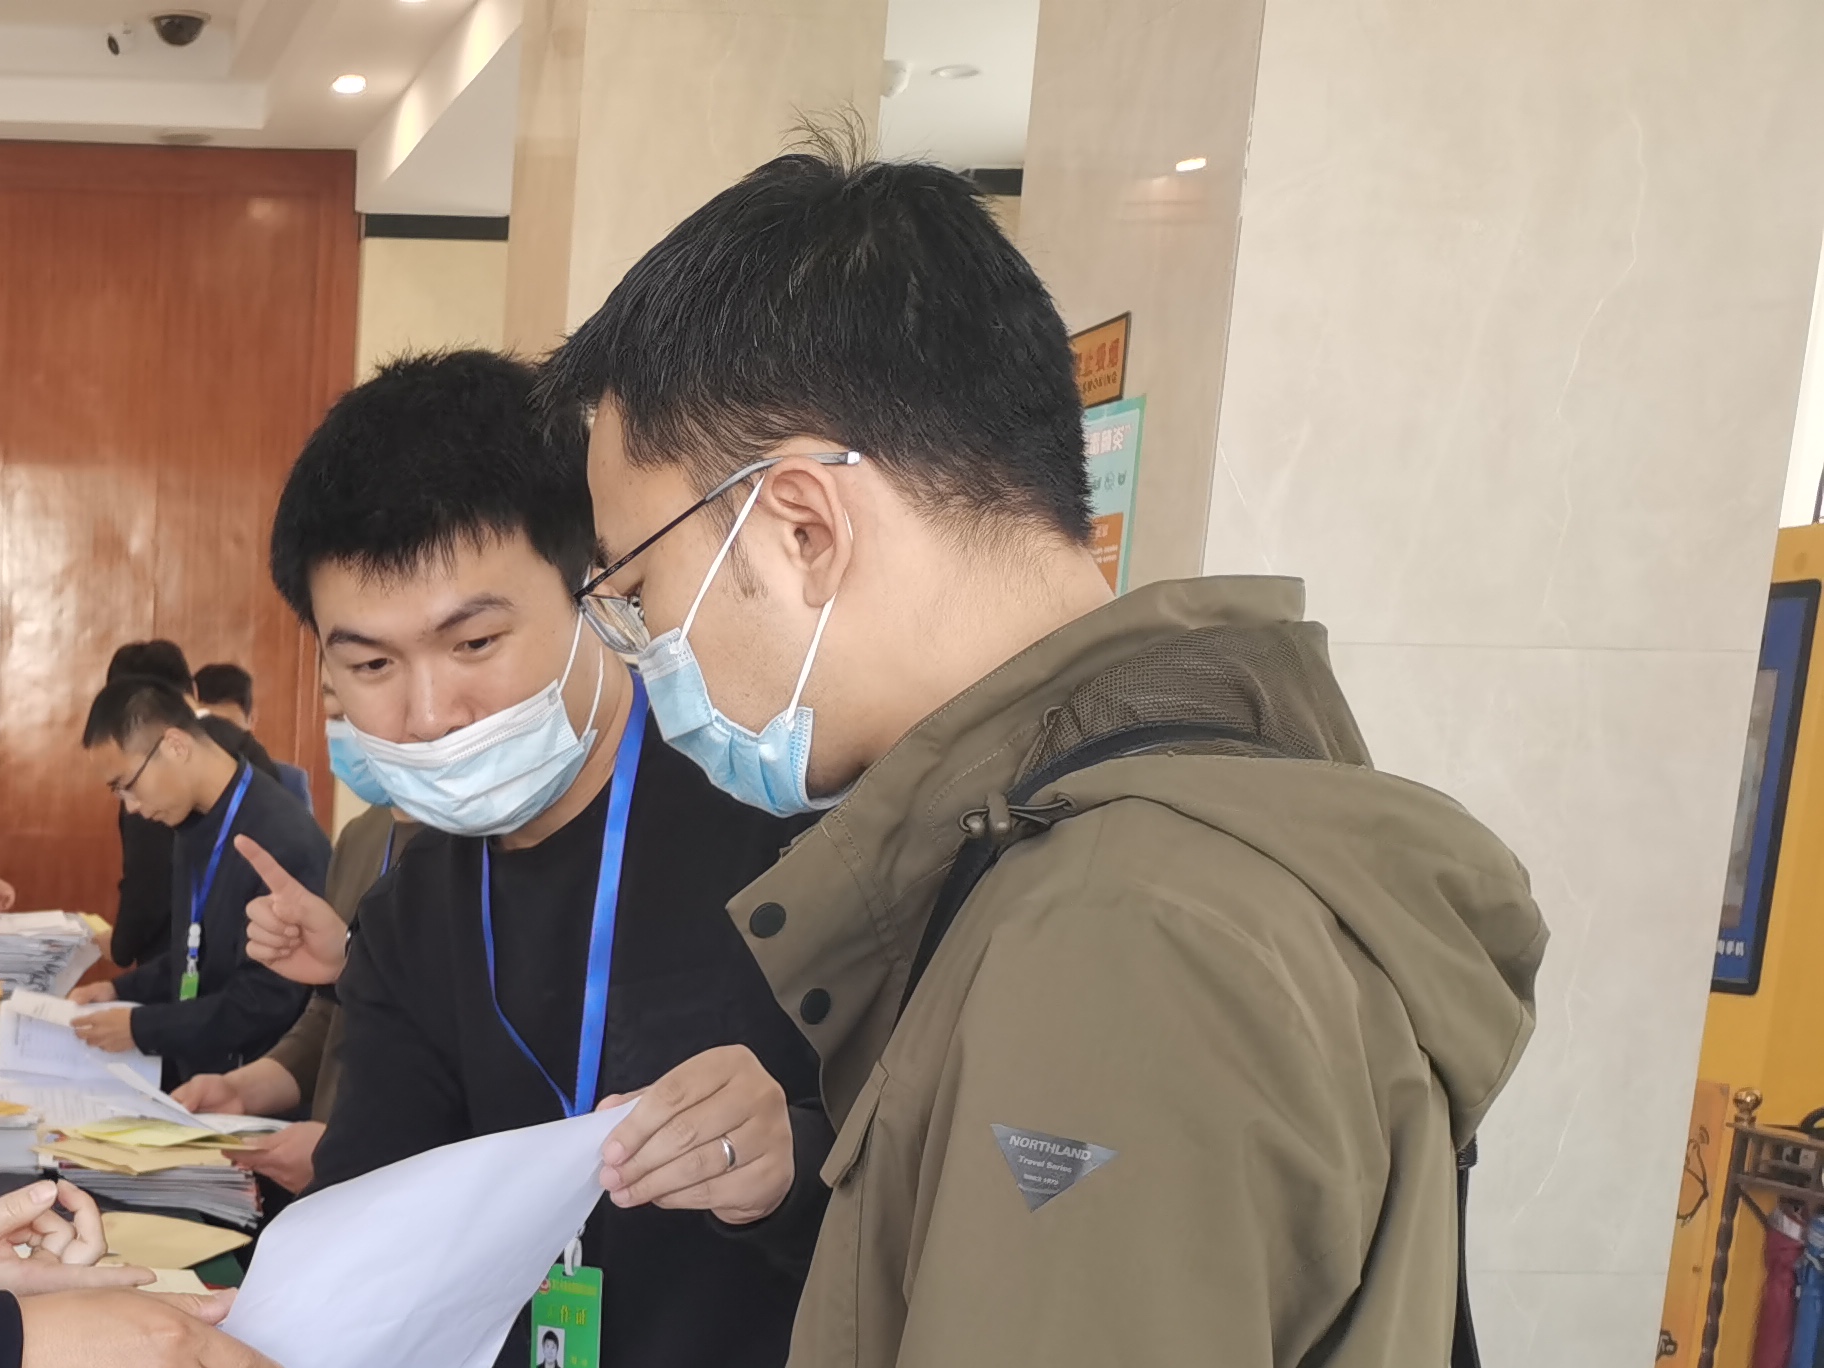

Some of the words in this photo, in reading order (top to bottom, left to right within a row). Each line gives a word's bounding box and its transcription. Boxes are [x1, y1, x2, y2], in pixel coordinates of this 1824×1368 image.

[1009, 1135, 1092, 1161] NORTHLAND
[1018, 1155, 1045, 1168] Travel
[1046, 1161, 1072, 1173] Series
